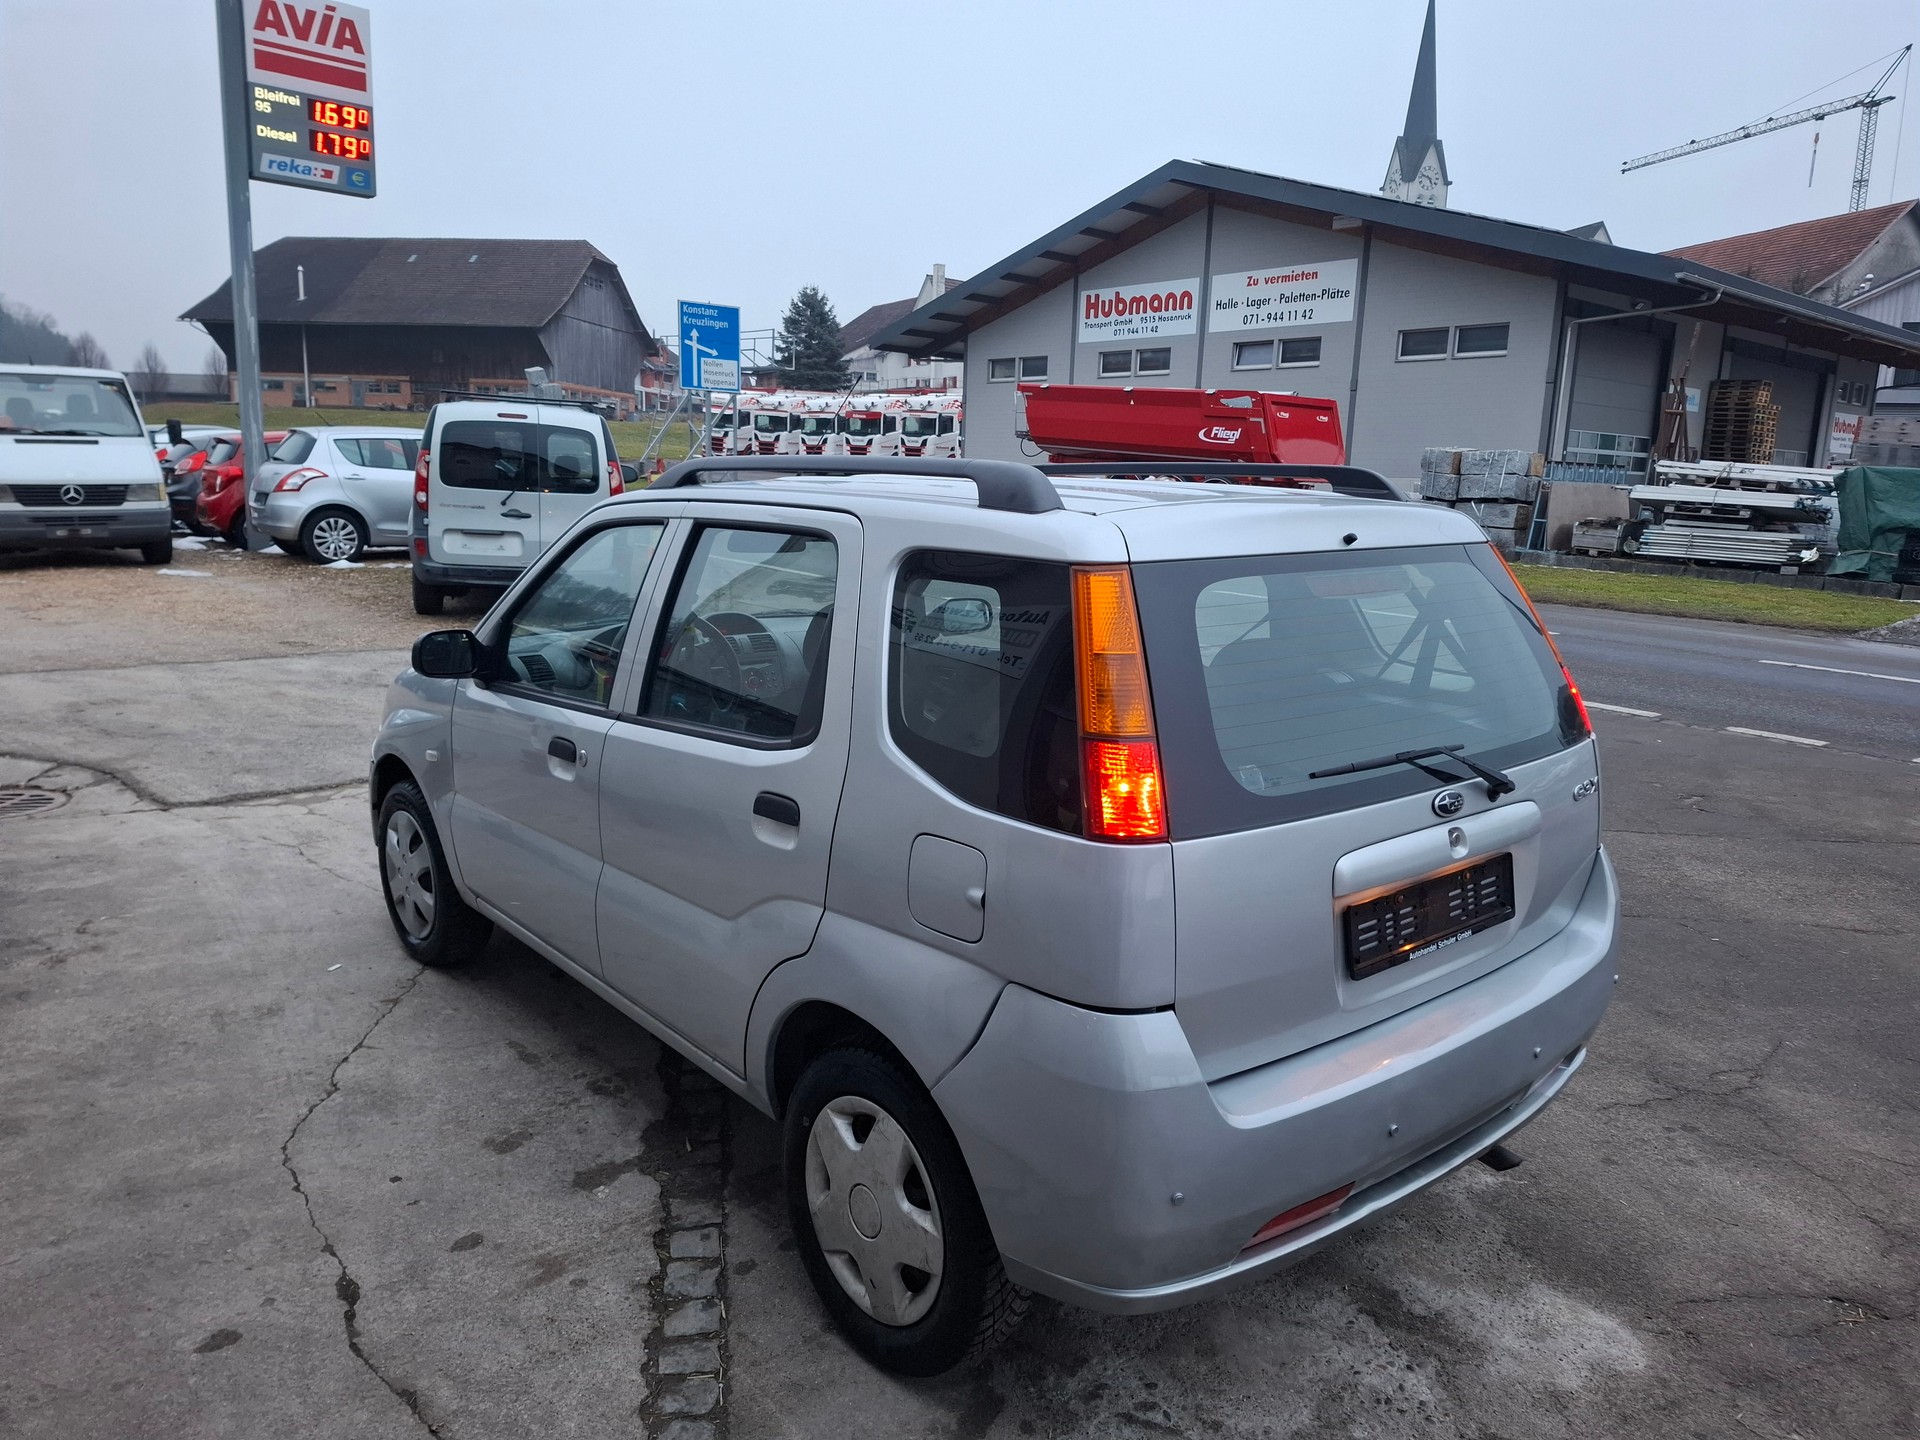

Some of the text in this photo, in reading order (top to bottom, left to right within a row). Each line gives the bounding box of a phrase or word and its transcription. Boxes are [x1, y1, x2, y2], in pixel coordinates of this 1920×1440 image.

[254, 87, 300, 107] Bleifrei
[254, 100, 272, 114] 95
[256, 125, 298, 143] Diesel
[1246, 270, 1319, 287] Zu vermieten
[1085, 290, 1193, 319] Hubmann
[1215, 287, 1351, 310] Halle Lager Paletten-Plätze
[683, 304, 718, 317] Konstanz
[1243, 308, 1314, 325] 071-944 11 42
[683, 316, 729, 329] Kreuzlingen
[1084, 313, 1192, 330] Transport GmbH 9515 Hosenruck
[1113, 325, 1159, 337] 071 944 11 42
[703, 360, 723, 368] Nollen
[703, 368, 735, 377] Hosenruck
[703, 378, 736, 387] Wuppenau
[1211, 426, 1242, 441] Fliegl
[1409, 943, 1438, 960] Autohandel
[1457, 929, 1472, 941] GmbH
